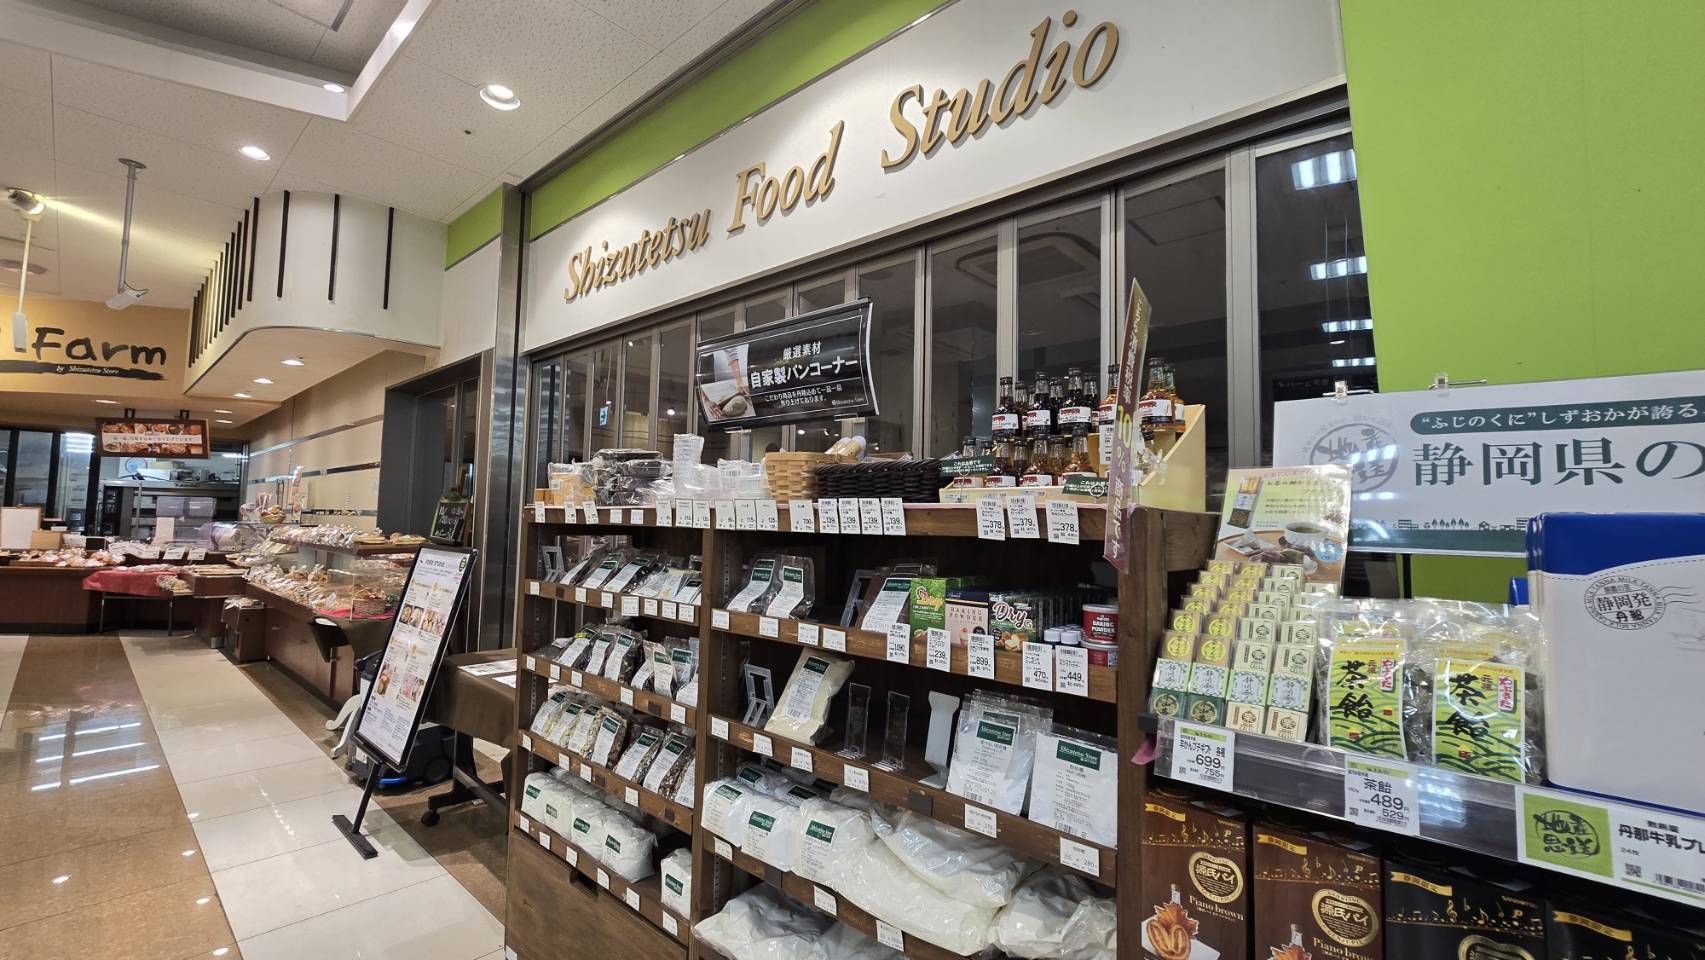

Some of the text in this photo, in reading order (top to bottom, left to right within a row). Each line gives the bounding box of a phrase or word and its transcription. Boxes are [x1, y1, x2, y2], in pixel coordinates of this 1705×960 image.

[564, 10, 1119, 301] Shizutetsu Food Studio
[32, 327, 167, 365] Farm
[1412, 437, 1705, 486] 静岡県の
[989, 520, 1002, 529] 378
[1019, 518, 1033, 526] 379
[1060, 522, 1075, 532] 378
[950, 606, 982, 616] BAKING
[1597, 591, 1652, 612] 静岡発
[949, 612, 983, 623] POWDER
[992, 601, 1028, 628] Dry
[1615, 610, 1644, 622] 丹那
[1033, 670, 1047, 679] 470
[1067, 671, 1082, 682] 449
[1336, 660, 1375, 719] 茶飴
[1498, 676, 1513, 710] やぶきた
[1446, 673, 1490, 737] 茶飴
[1363, 777, 1392, 795] 茶飴
[1195, 863, 1234, 884] 源氏パイ
[1189, 895, 1216, 911] Piano
[1215, 903, 1244, 921] brown
[1320, 903, 1369, 926] 源氏パイ
[1312, 936, 1344, 955] Piano
